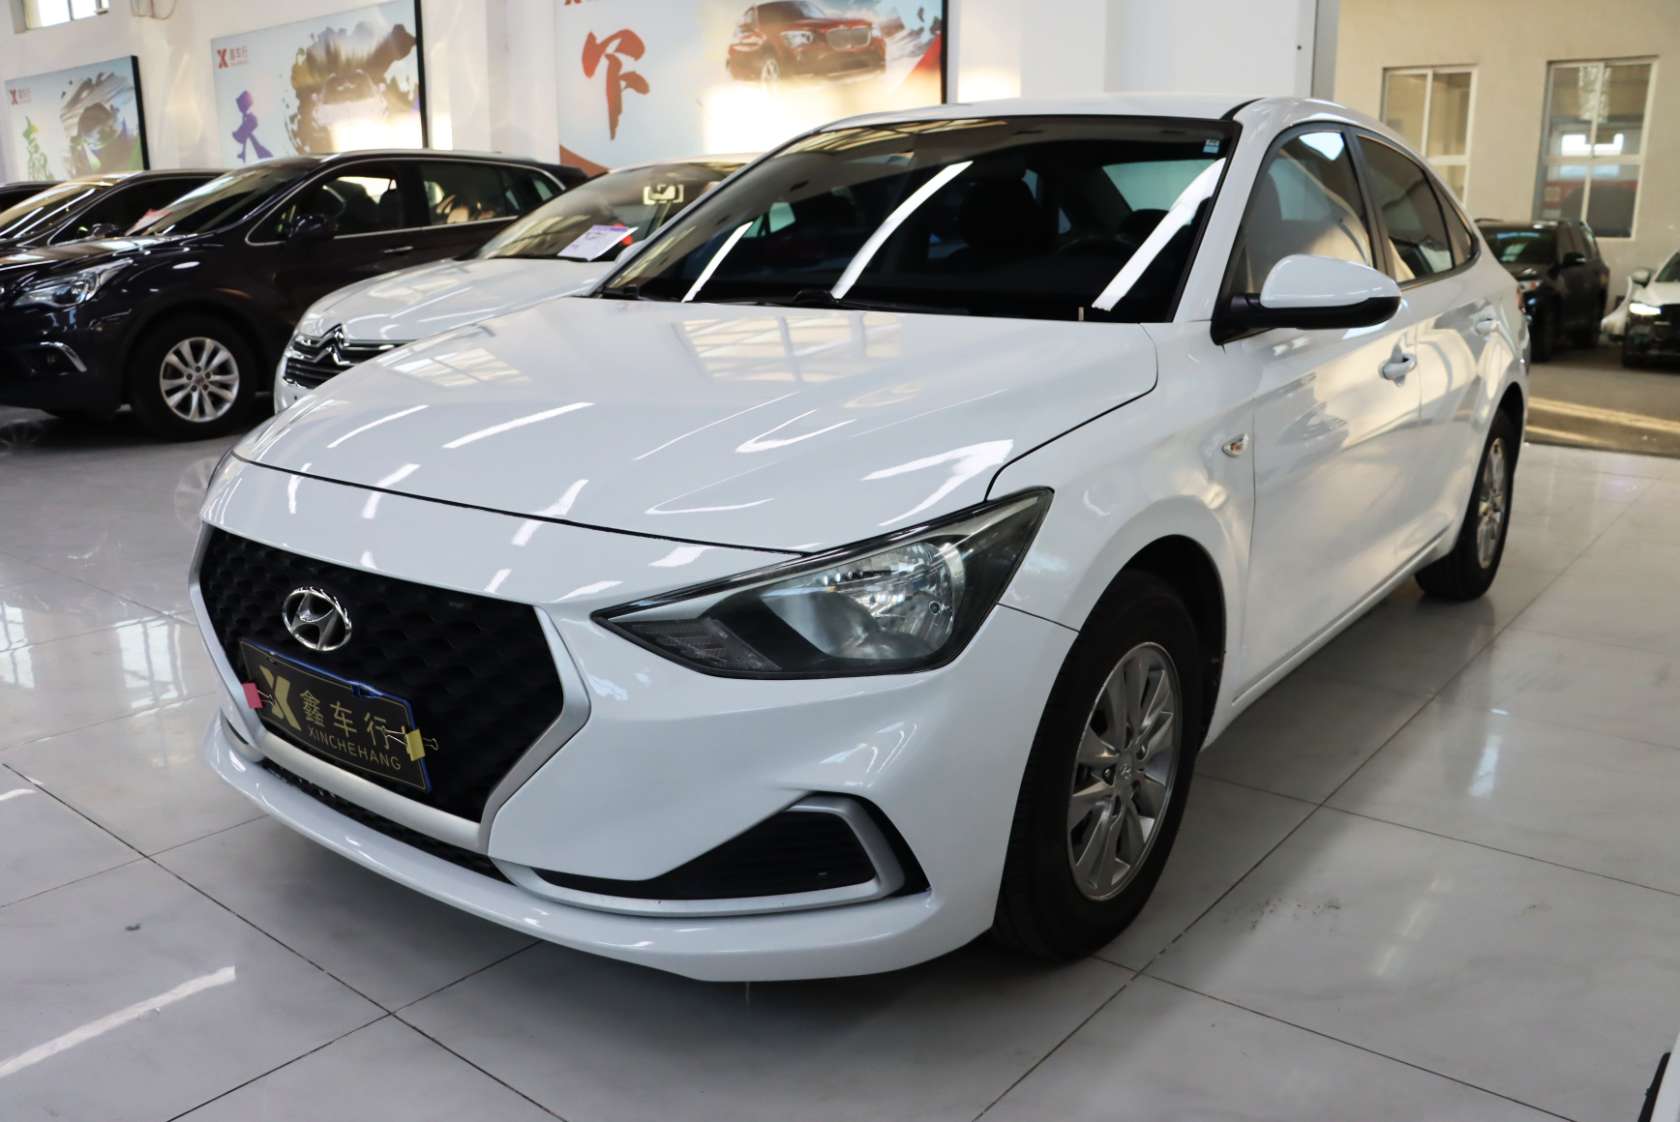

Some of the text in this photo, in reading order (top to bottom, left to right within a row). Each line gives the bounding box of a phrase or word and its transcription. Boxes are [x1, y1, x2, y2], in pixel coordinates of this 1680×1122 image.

[301, 690, 390, 750] 鑫车行
[308, 727, 401, 770] XINCHEHANG
